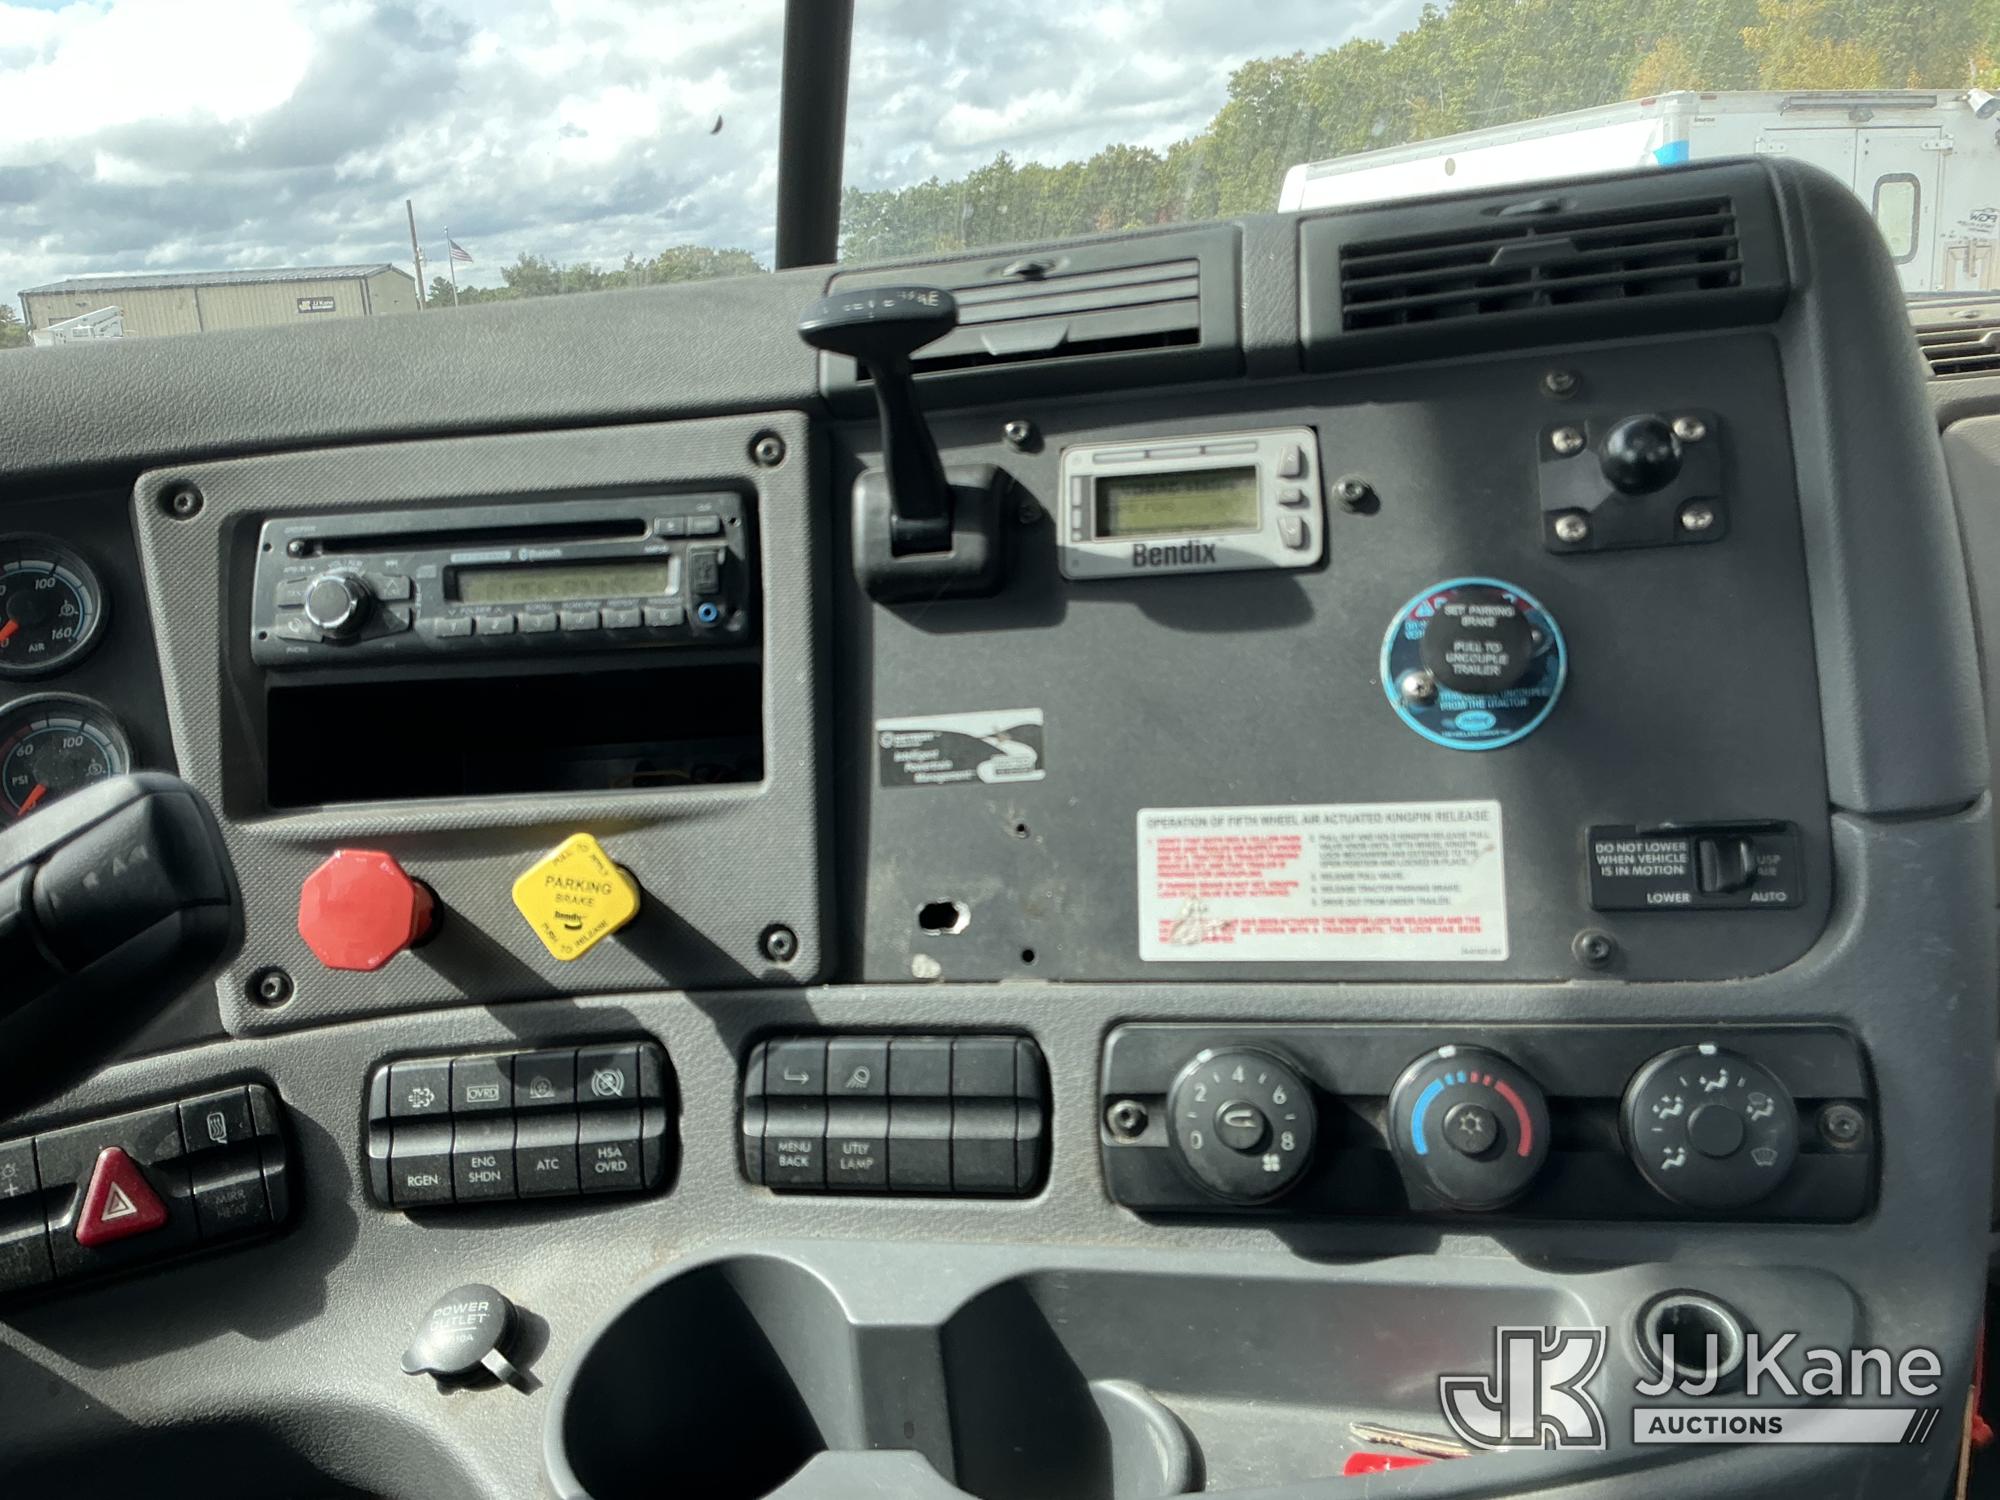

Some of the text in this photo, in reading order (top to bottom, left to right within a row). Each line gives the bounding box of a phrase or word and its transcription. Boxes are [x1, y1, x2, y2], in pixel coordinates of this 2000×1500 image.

[1133, 541, 1216, 567] Bendix
[35, 578, 56, 590] 100
[1469, 605, 1515, 617] PARKING
[1460, 617, 1496, 628] BRAKE
[52, 627, 73, 640] 160
[28, 643, 45, 653] AIR
[1453, 641, 1502, 653] PULL TO
[1445, 652, 1510, 665] UNCOUPLE
[1453, 665, 1502, 676] TRAILER
[63, 736, 84, 748] 100
[16, 744, 34, 757] 60
[12, 775, 28, 786] PSI
[1261, 815, 1298, 827] WHEEL
[1302, 814, 1320, 825] AIR
[1323, 813, 1384, 824] ACTUATED
[1386, 812, 1431, 823] KINGPIN
[1435, 811, 1489, 822] RELEASE
[1595, 841, 1688, 854] DO NOT LOWER
[1597, 853, 1687, 865] WHEN VEHICLE
[1601, 865, 1685, 876] IS IN MOTION
[544, 875, 613, 896] PARKING
[555, 893, 596, 907] BRAKE
[1646, 892, 1691, 904] LOWER
[1751, 892, 1787, 902] AUTO
[1232, 1065, 1245, 1082] 4
[468, 1086, 499, 1100] OVRD
[1194, 1085, 1207, 1102] 2
[1272, 1085, 1287, 1105] 6
[1190, 1131, 1203, 1150] 0
[1280, 1132, 1296, 1151] 8
[597, 1147, 623, 1158] HSA
[778, 1142, 812, 1154] MENU
[471, 1156, 496, 1168] ENG
[536, 1159, 560, 1171] ATC
[595, 1160, 627, 1174] OVRD
[779, 1156, 809, 1168] BACK
[840, 1157, 874, 1170] LAMP
[407, 1175, 438, 1187] RGEN
[468, 1171, 501, 1183] SHDN
[432, 1301, 489, 1319] POWER
[429, 1313, 488, 1332] OUTLET
